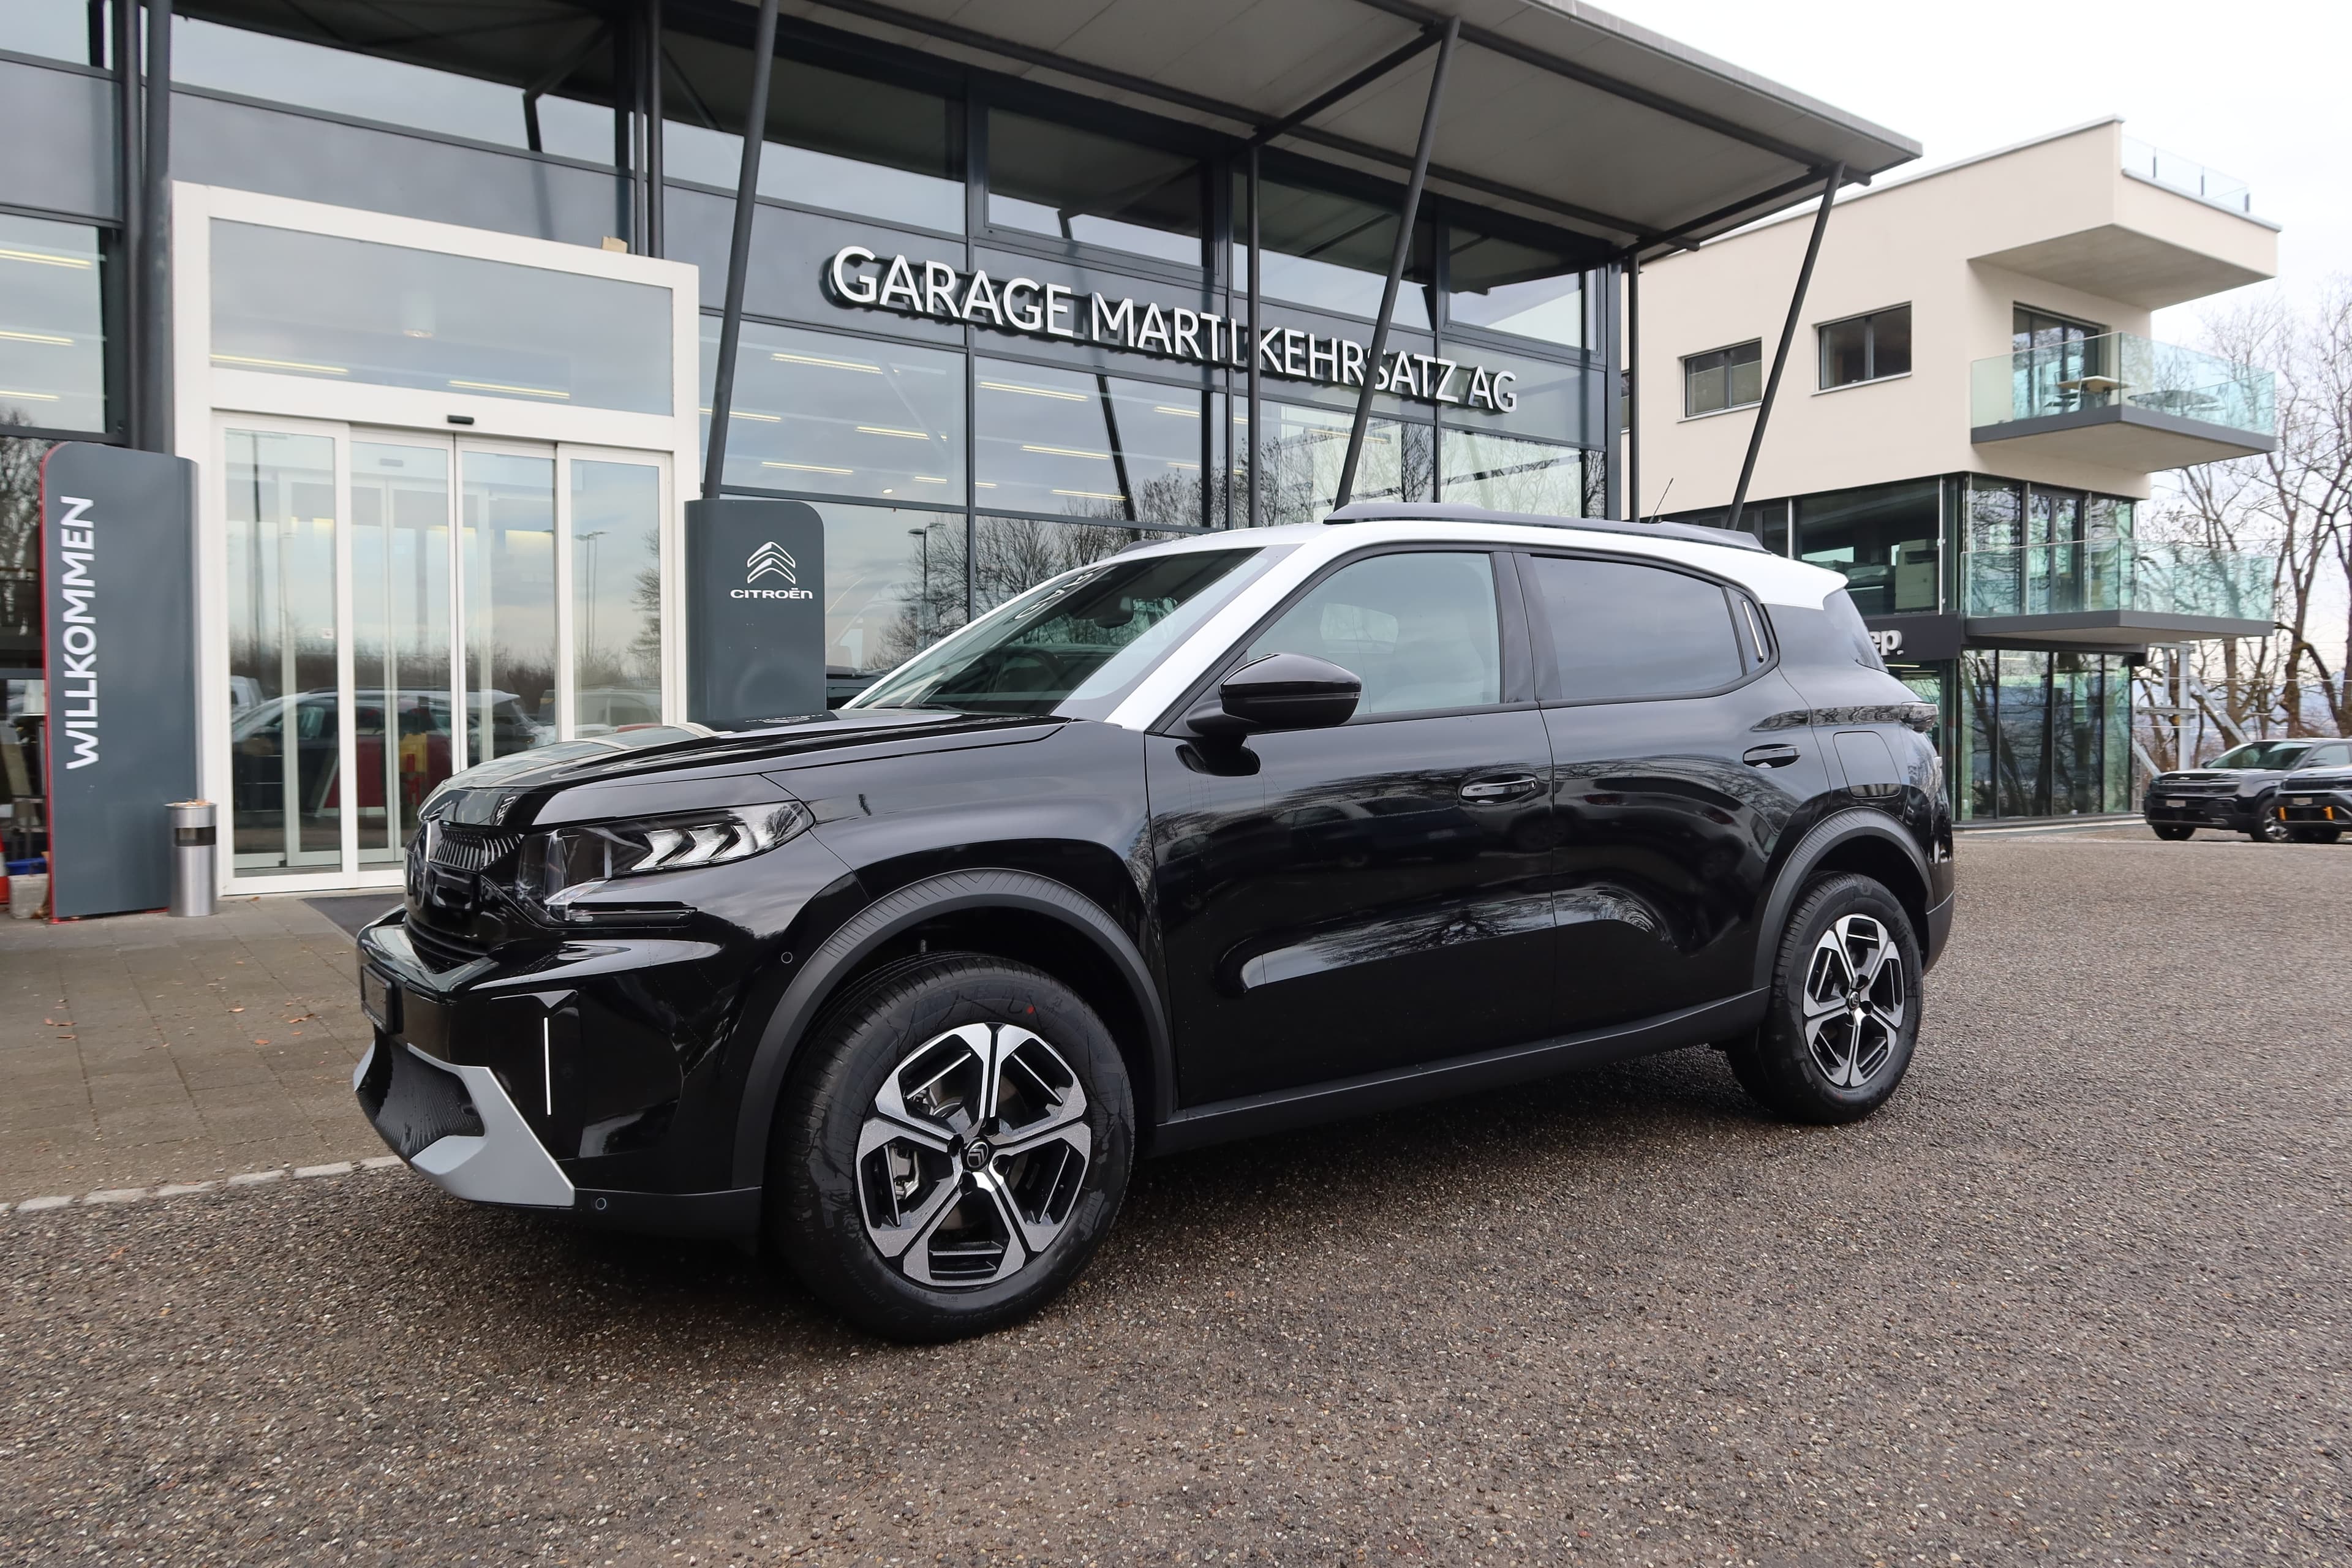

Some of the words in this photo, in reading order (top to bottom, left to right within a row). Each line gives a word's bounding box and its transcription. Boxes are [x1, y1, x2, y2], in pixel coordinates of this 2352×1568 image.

[832, 246, 1074, 336] GARAGE
[1091, 292, 1237, 364] MARTI
[1469, 366, 1518, 412] AG
[60, 496, 99, 770] WILLKOMMEN
